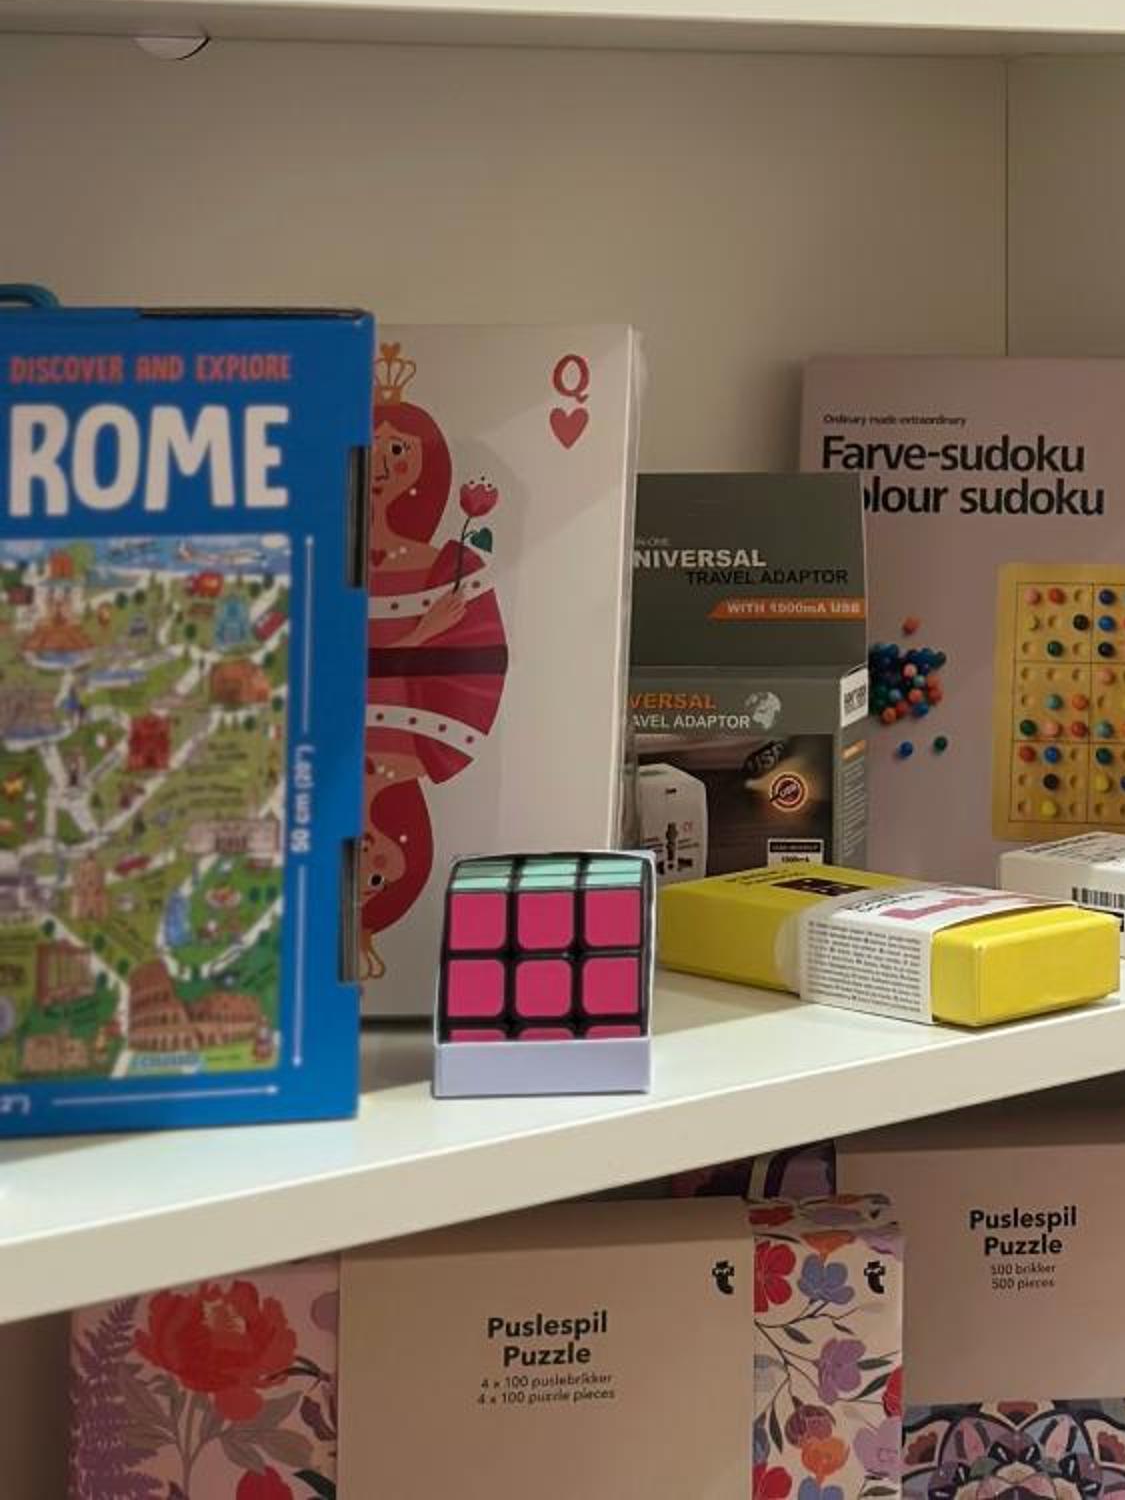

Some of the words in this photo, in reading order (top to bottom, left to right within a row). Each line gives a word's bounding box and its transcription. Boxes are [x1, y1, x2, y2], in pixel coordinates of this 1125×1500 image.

[10, 355, 124, 384] DISCOVER
[135, 355, 184, 383] AND
[195, 354, 291, 382] EXPLORE
[553, 353, 590, 404] Q
[822, 414, 867, 427] Ordinary
[869, 414, 897, 425] made
[899, 414, 967, 427] extraordinary
[9, 403, 290, 517] ROME
[822, 434, 1085, 472] Farve-sudoku
[959, 477, 1105, 516] sudoku
[633, 549, 768, 569] NIVERSAL
[686, 570, 755, 586] TRAVEL
[760, 569, 849, 585] ADAPTOR
[727, 602, 765, 614] WITH
[831, 601, 862, 613] USB
[630, 692, 717, 710] VERSAL
[633, 714, 670, 730] AVEL
[673, 714, 751, 729] ADAPTOR
[289, 827, 312, 855] 50
[969, 1204, 1078, 1233] Puslespil
[984, 1233, 1063, 1257] Puzzle
[1015, 1261, 1056, 1275] brikker
[991, 1277, 1015, 1290] 500
[1017, 1277, 1056, 1291] pieces
[487, 1309, 608, 1341] Puslespil
[503, 1341, 592, 1368] Puzzle
[480, 1377, 489, 1389] 4
[505, 1375, 529, 1389] 100
[531, 1373, 613, 1389] puslebrikker
[477, 1393, 486, 1404] 4
[502, 1391, 526, 1404] 100
[528, 1389, 570, 1405] puzzle
[573, 1387, 616, 1403] pieces
